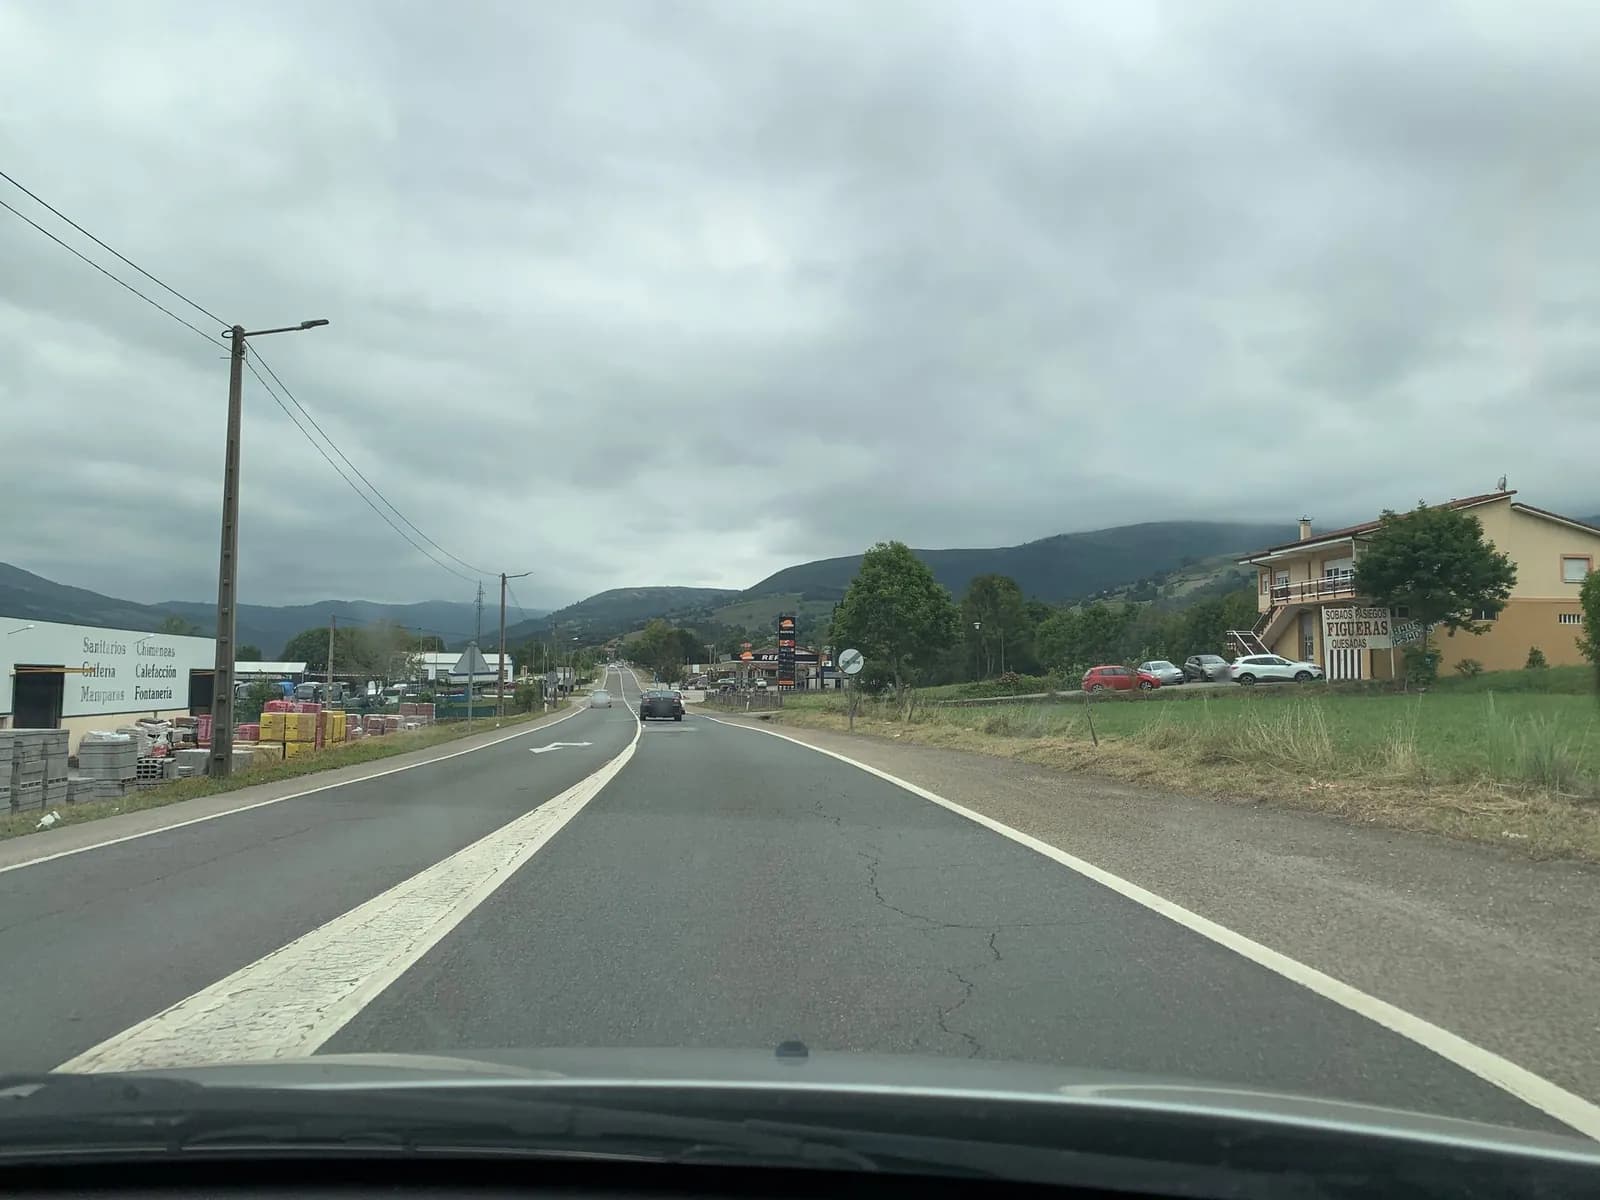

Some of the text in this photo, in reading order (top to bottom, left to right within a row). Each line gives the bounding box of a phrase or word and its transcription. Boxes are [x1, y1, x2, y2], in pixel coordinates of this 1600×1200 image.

[1326, 610, 1353, 619] SOBAOS
[1327, 621, 1388, 637] FIGUERAS
[83, 637, 126, 655] Sanitarios
[136, 641, 175, 657] Chimeneas
[1332, 639, 1367, 649] QUESADAS
[136, 664, 176, 678] Calefacción
[80, 686, 125, 705] Mamparas
